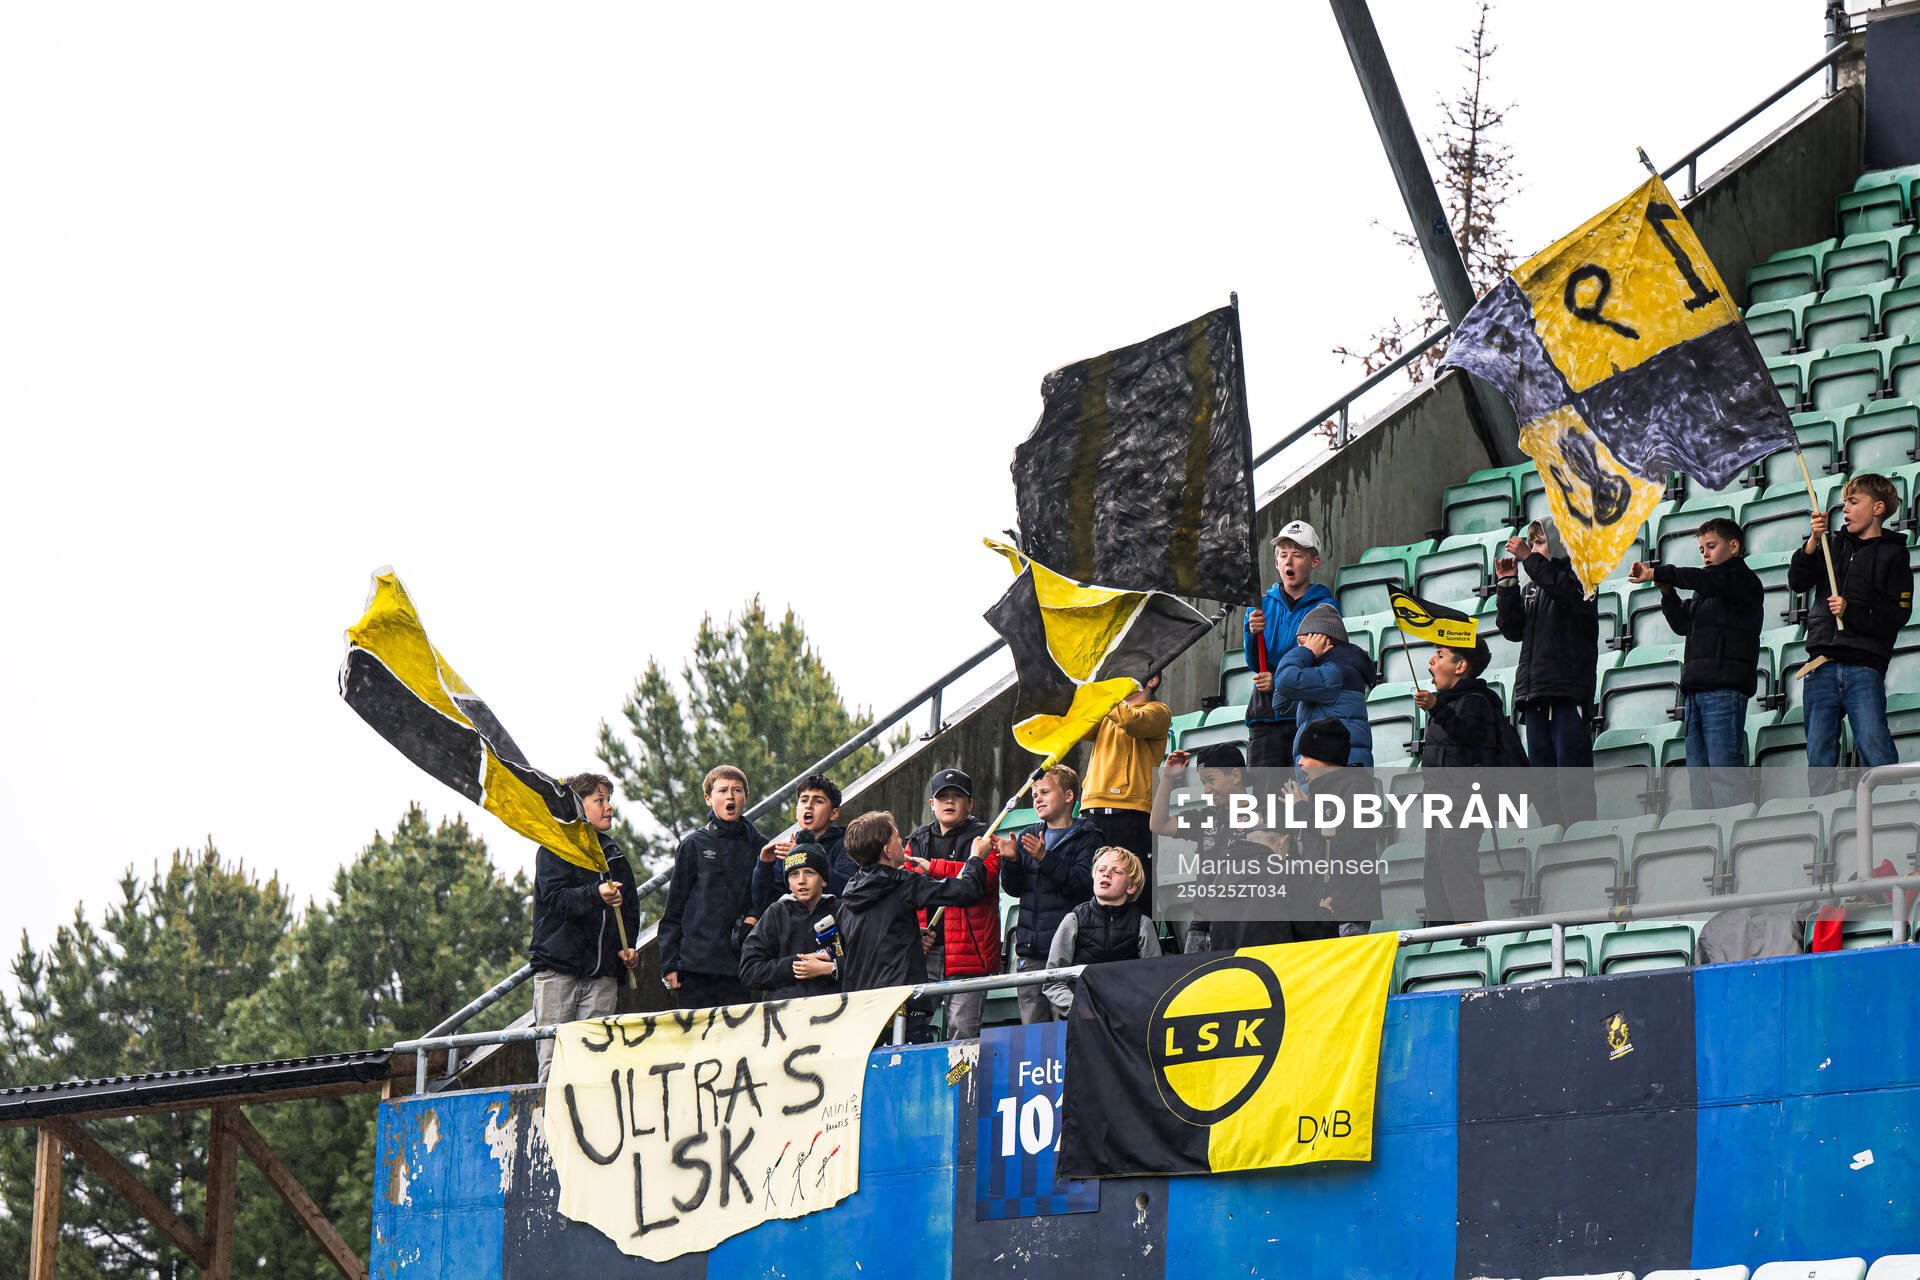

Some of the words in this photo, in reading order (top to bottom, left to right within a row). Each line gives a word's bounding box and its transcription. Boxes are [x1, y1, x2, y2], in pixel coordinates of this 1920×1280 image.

[1164, 1017, 1267, 1057] LSK
[1018, 1058, 1063, 1087] Felt
[564, 1044, 825, 1166] ULTRAS
[1297, 1109, 1352, 1150] DNB
[631, 1124, 755, 1238] LSK
